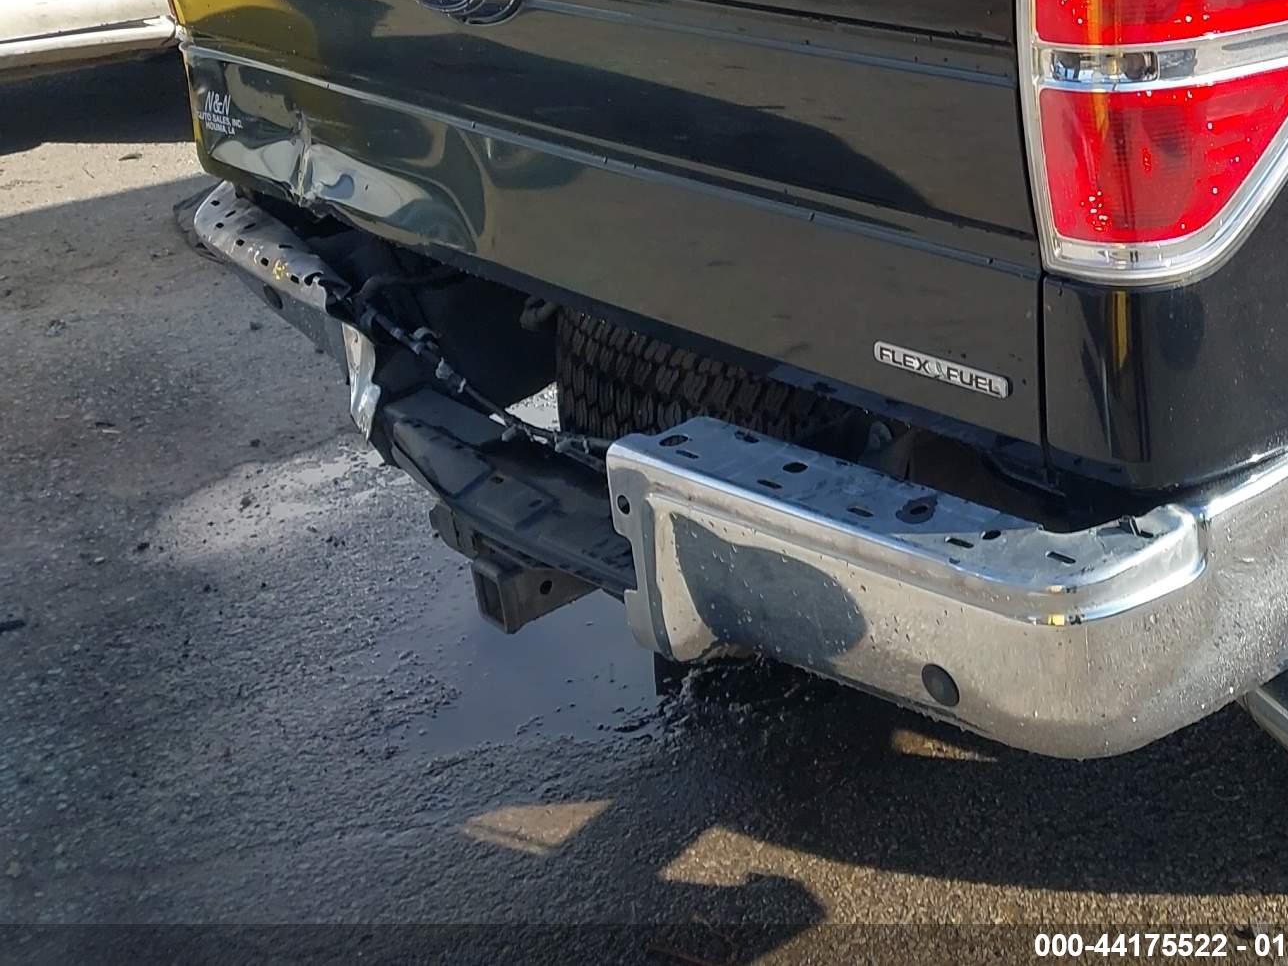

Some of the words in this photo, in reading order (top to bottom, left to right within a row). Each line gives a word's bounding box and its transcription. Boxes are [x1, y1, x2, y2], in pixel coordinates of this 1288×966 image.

[204, 90, 231, 116] N&N
[879, 346, 931, 375] FLEX
[946, 366, 1001, 396] FUEL
